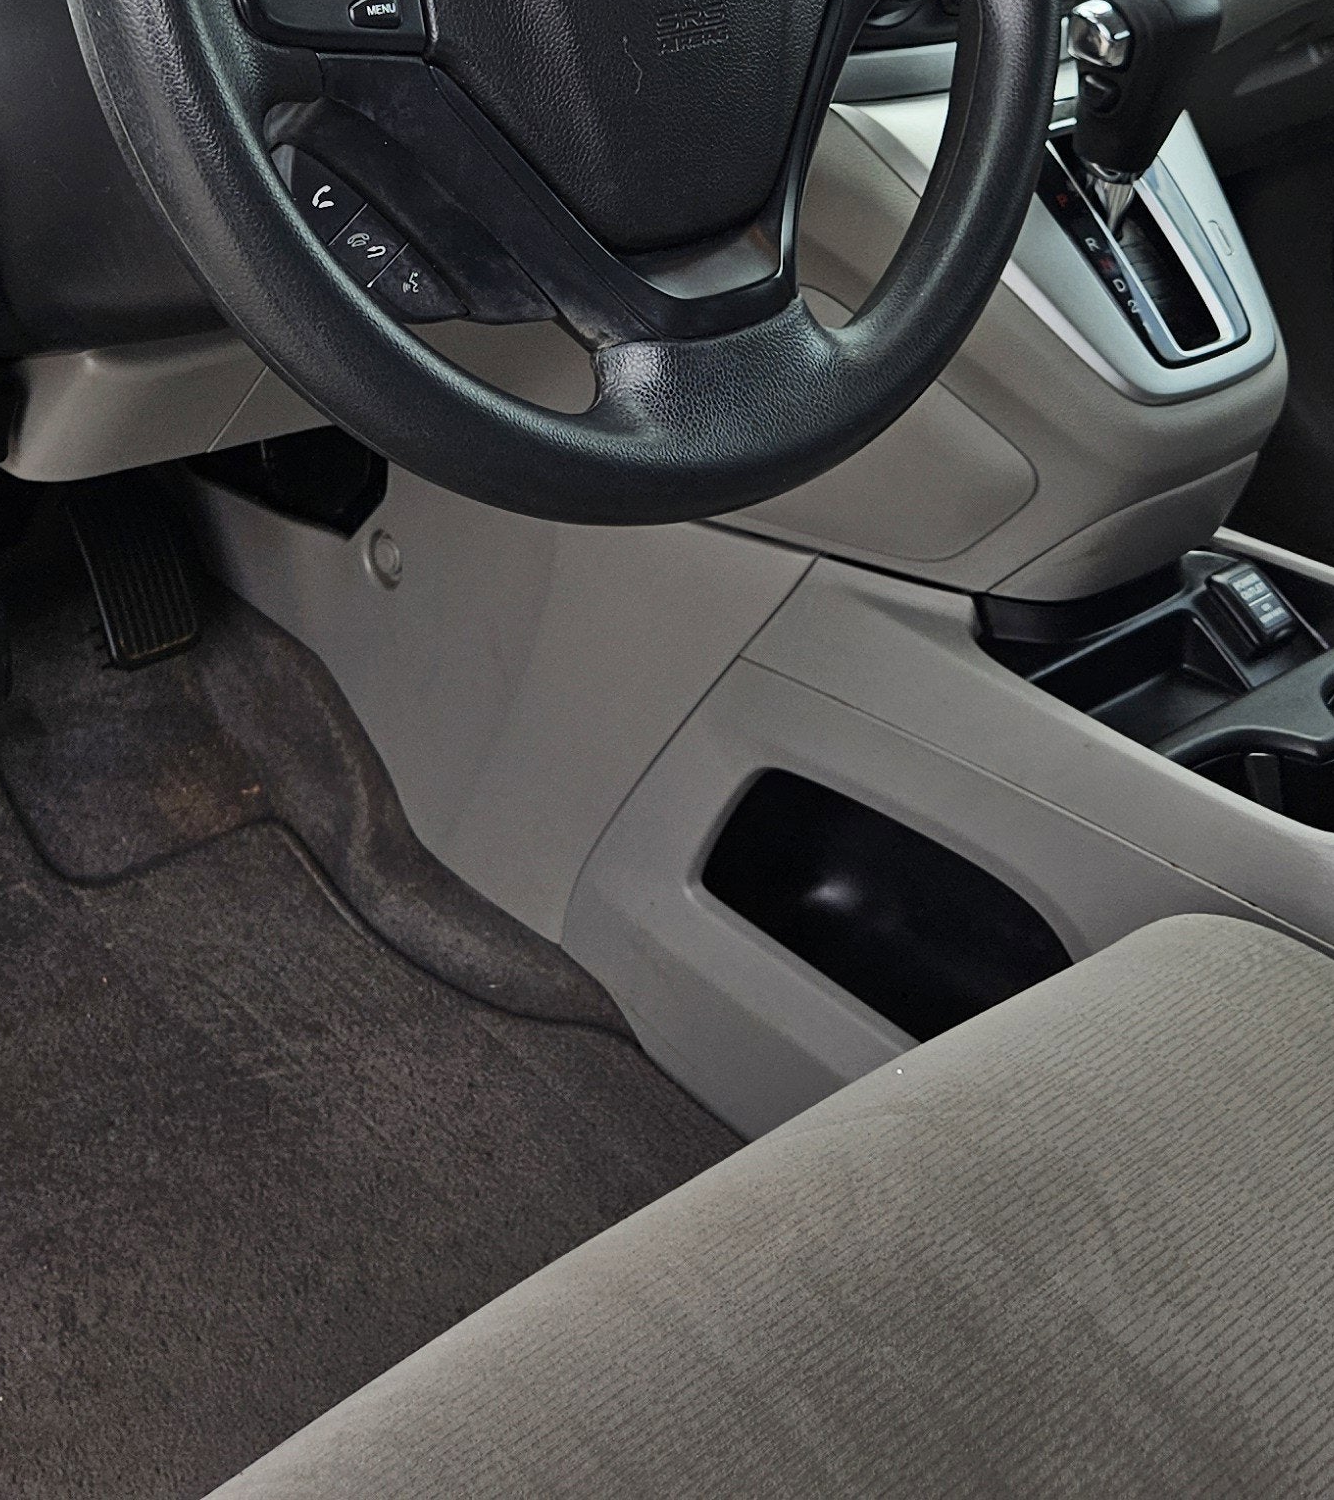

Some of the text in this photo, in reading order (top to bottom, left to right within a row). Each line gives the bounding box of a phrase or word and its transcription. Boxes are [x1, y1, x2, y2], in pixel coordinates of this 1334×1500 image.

[366, 2, 397, 16] MENU
[1085, 237, 1100, 252] R
[1112, 278, 1127, 293] D
